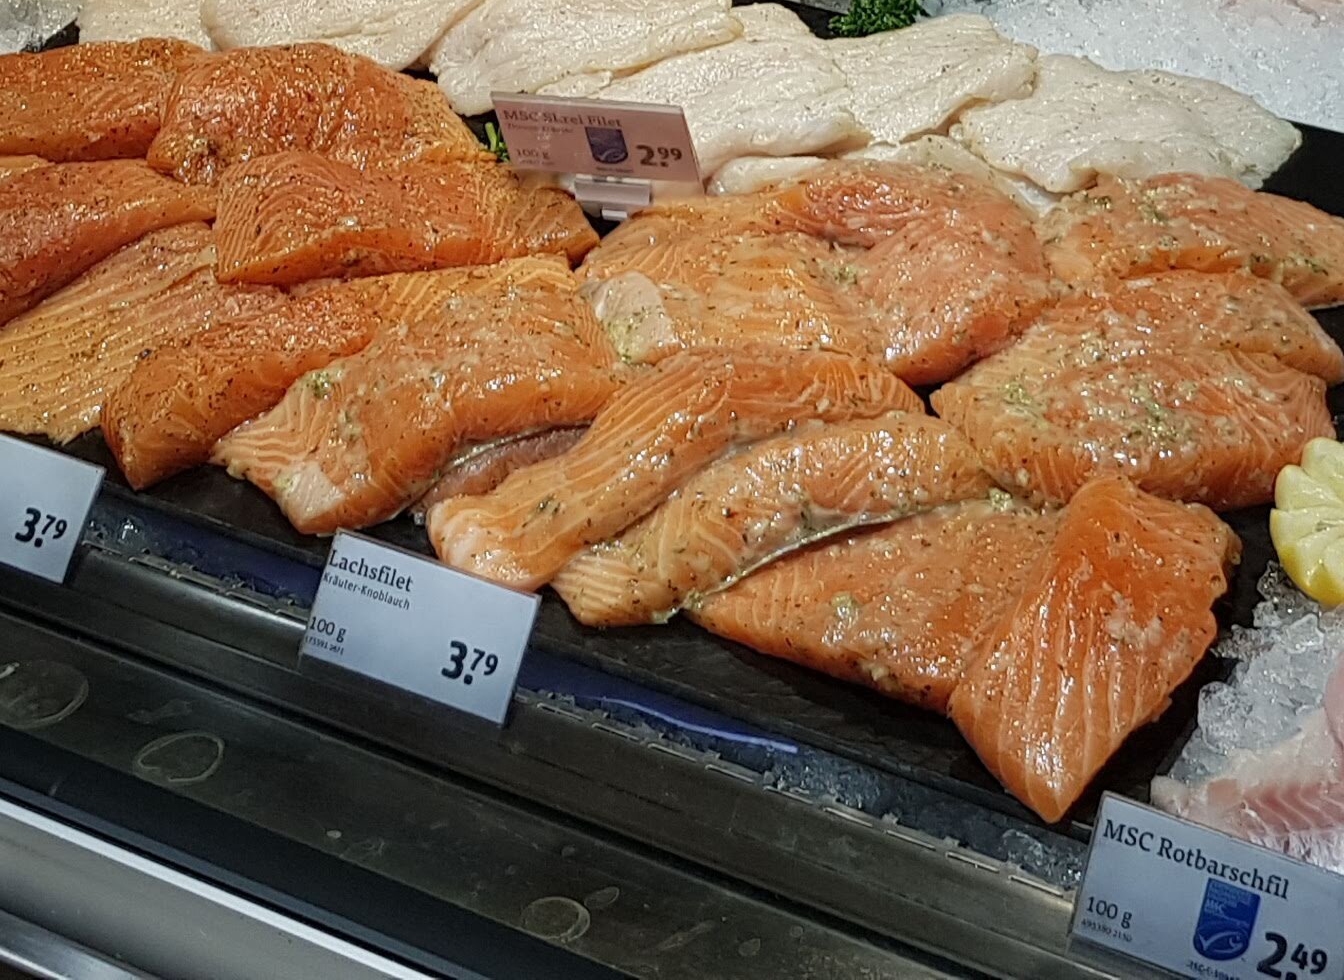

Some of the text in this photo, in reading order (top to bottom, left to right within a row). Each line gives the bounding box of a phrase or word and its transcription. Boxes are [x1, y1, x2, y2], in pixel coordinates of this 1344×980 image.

[587, 115, 622, 127] Filet
[636, 145, 682, 167] 2.99
[15, 507, 68, 548] 3.79
[328, 549, 414, 592] Lachsfilet
[323, 572, 410, 610] Kräuter-Knoblauch
[309, 617, 347, 644] 100 g
[441, 640, 499, 685] 3.79
[1102, 819, 1154, 852] MSC
[1157, 837, 1289, 900] Rotbarschfil
[1086, 896, 1119, 919] 100
[1121, 910, 1133, 930] g
